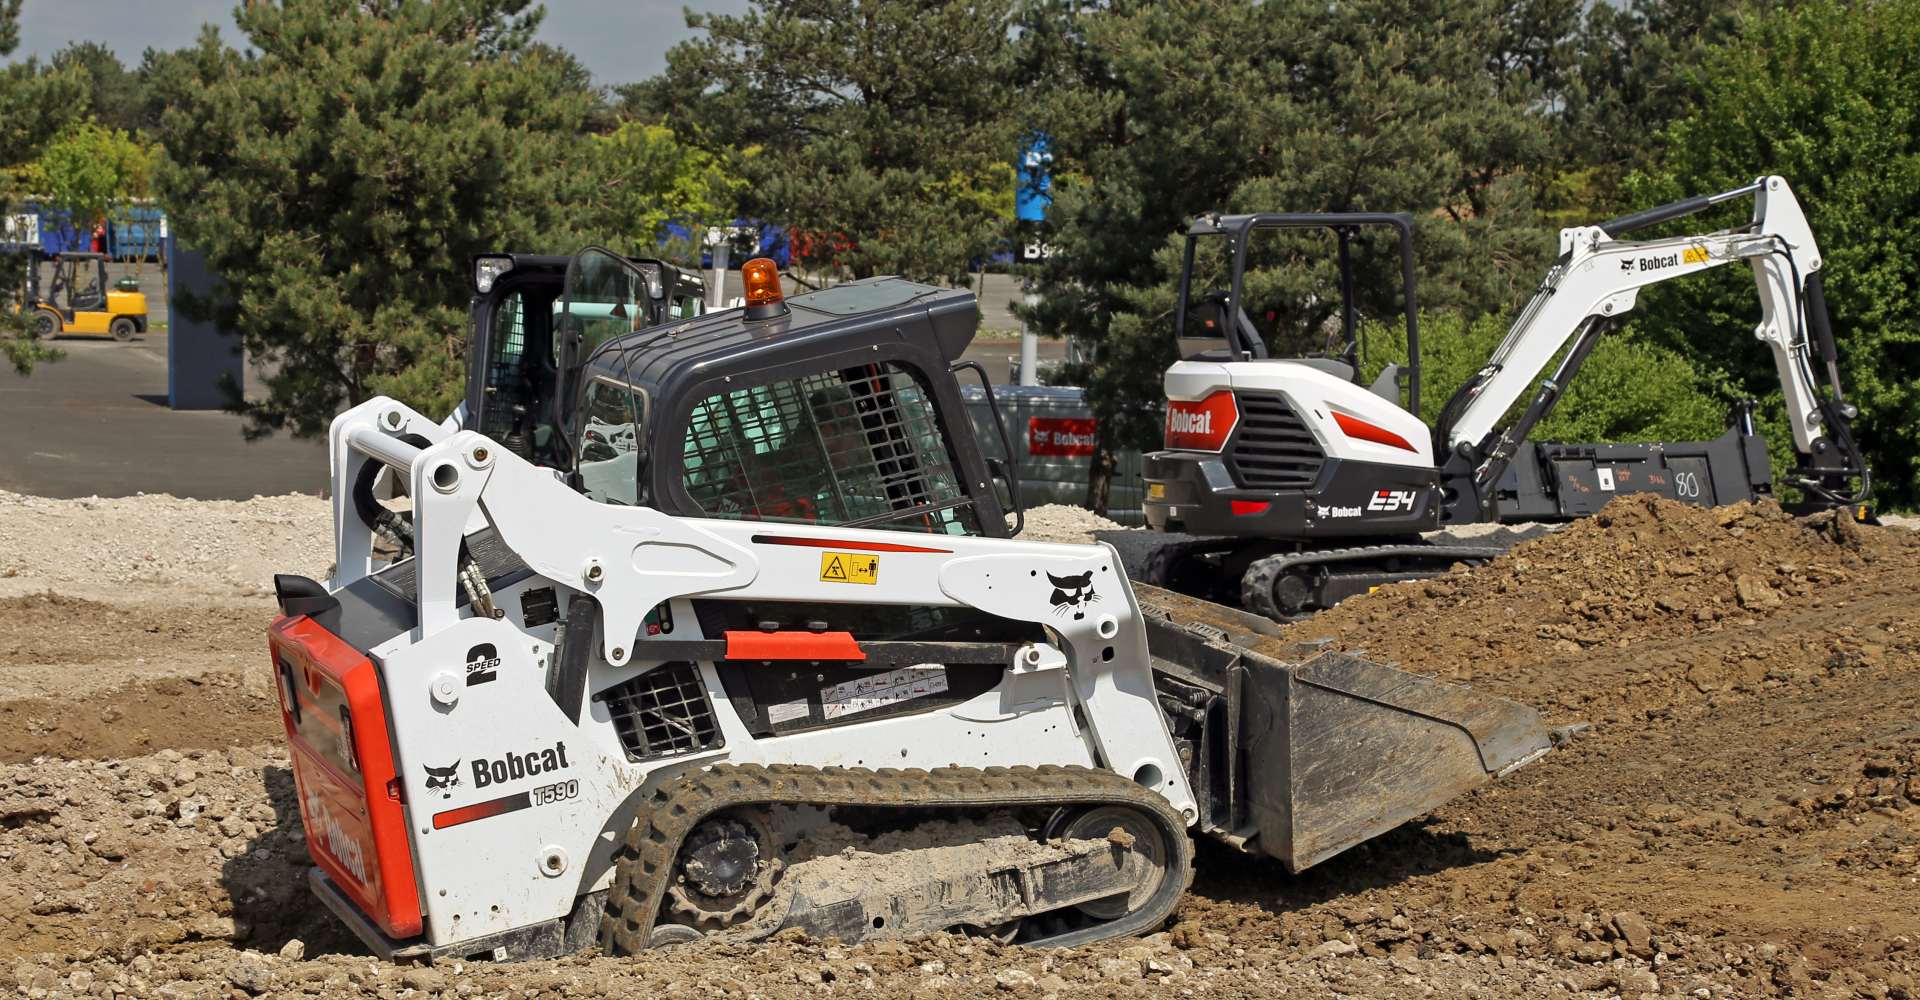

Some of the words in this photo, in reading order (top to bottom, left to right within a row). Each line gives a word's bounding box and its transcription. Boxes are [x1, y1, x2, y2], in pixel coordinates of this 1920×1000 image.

[1640, 253, 1678, 272] Bobcat
[1171, 408, 1211, 434] Bobcat
[1675, 472, 1699, 497] 80
[1332, 506, 1362, 517] Bobcat
[1367, 490, 1416, 511] E34
[466, 643, 498, 687] 2
[466, 658, 501, 673] SPEED
[471, 741, 569, 788] Bobcat
[533, 779, 579, 806] T590
